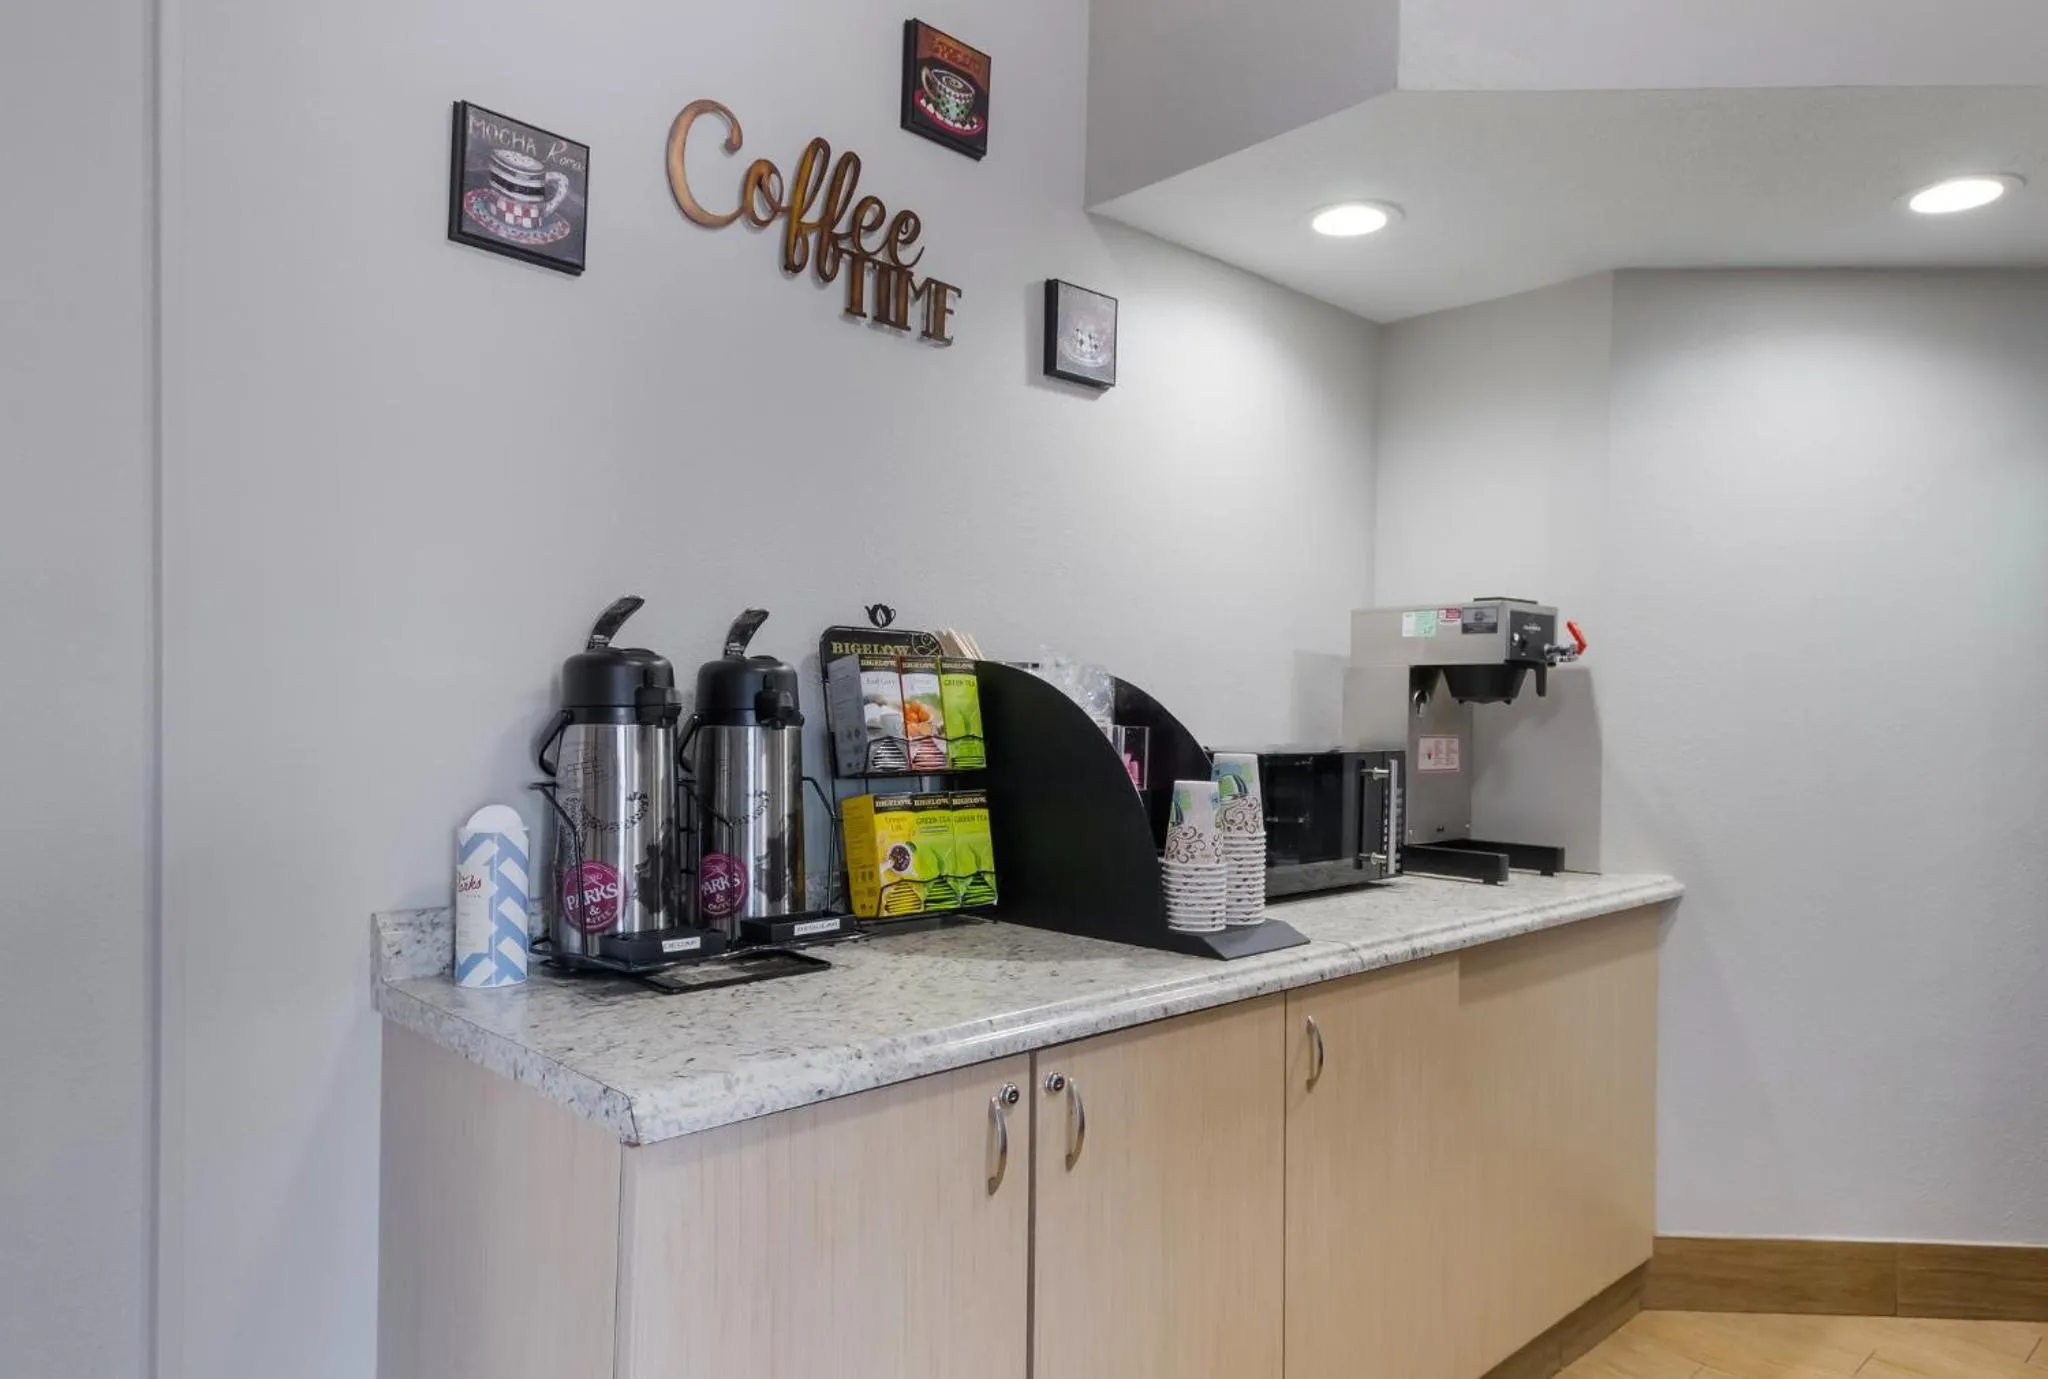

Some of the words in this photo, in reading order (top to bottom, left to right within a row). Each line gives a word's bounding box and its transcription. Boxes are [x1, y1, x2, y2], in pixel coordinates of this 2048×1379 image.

[467, 113, 537, 155] MOCHA
[666, 98, 926, 283] Coffee
[838, 250, 962, 347] TIME
[831, 641, 911, 656] BIGELOW
[589, 905, 601, 915] &
